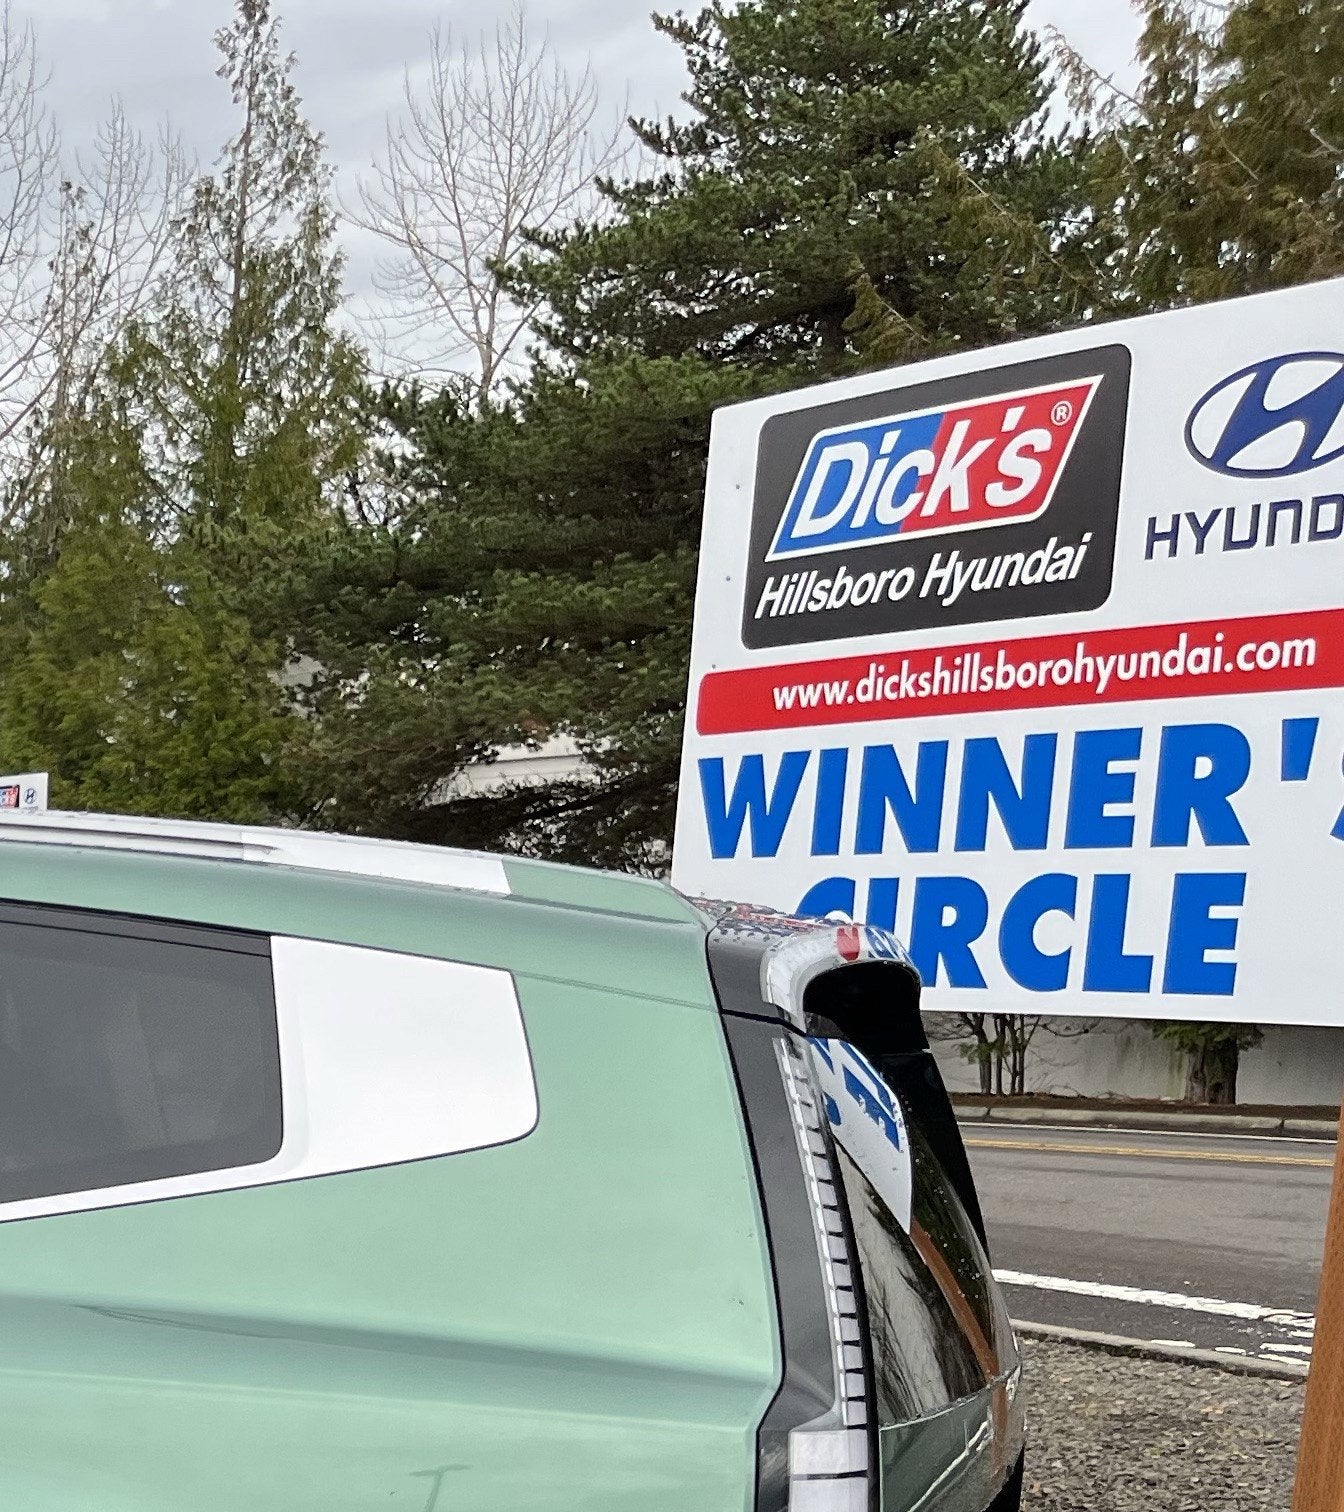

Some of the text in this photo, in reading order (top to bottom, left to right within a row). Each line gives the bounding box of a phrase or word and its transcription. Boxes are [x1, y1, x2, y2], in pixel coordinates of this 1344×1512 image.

[754, 532, 1093, 619] Hillsboro Hyundai
[773, 633, 1317, 711] www.dickshillsborohyundai.com
[698, 717, 1344, 859] WINNER'
